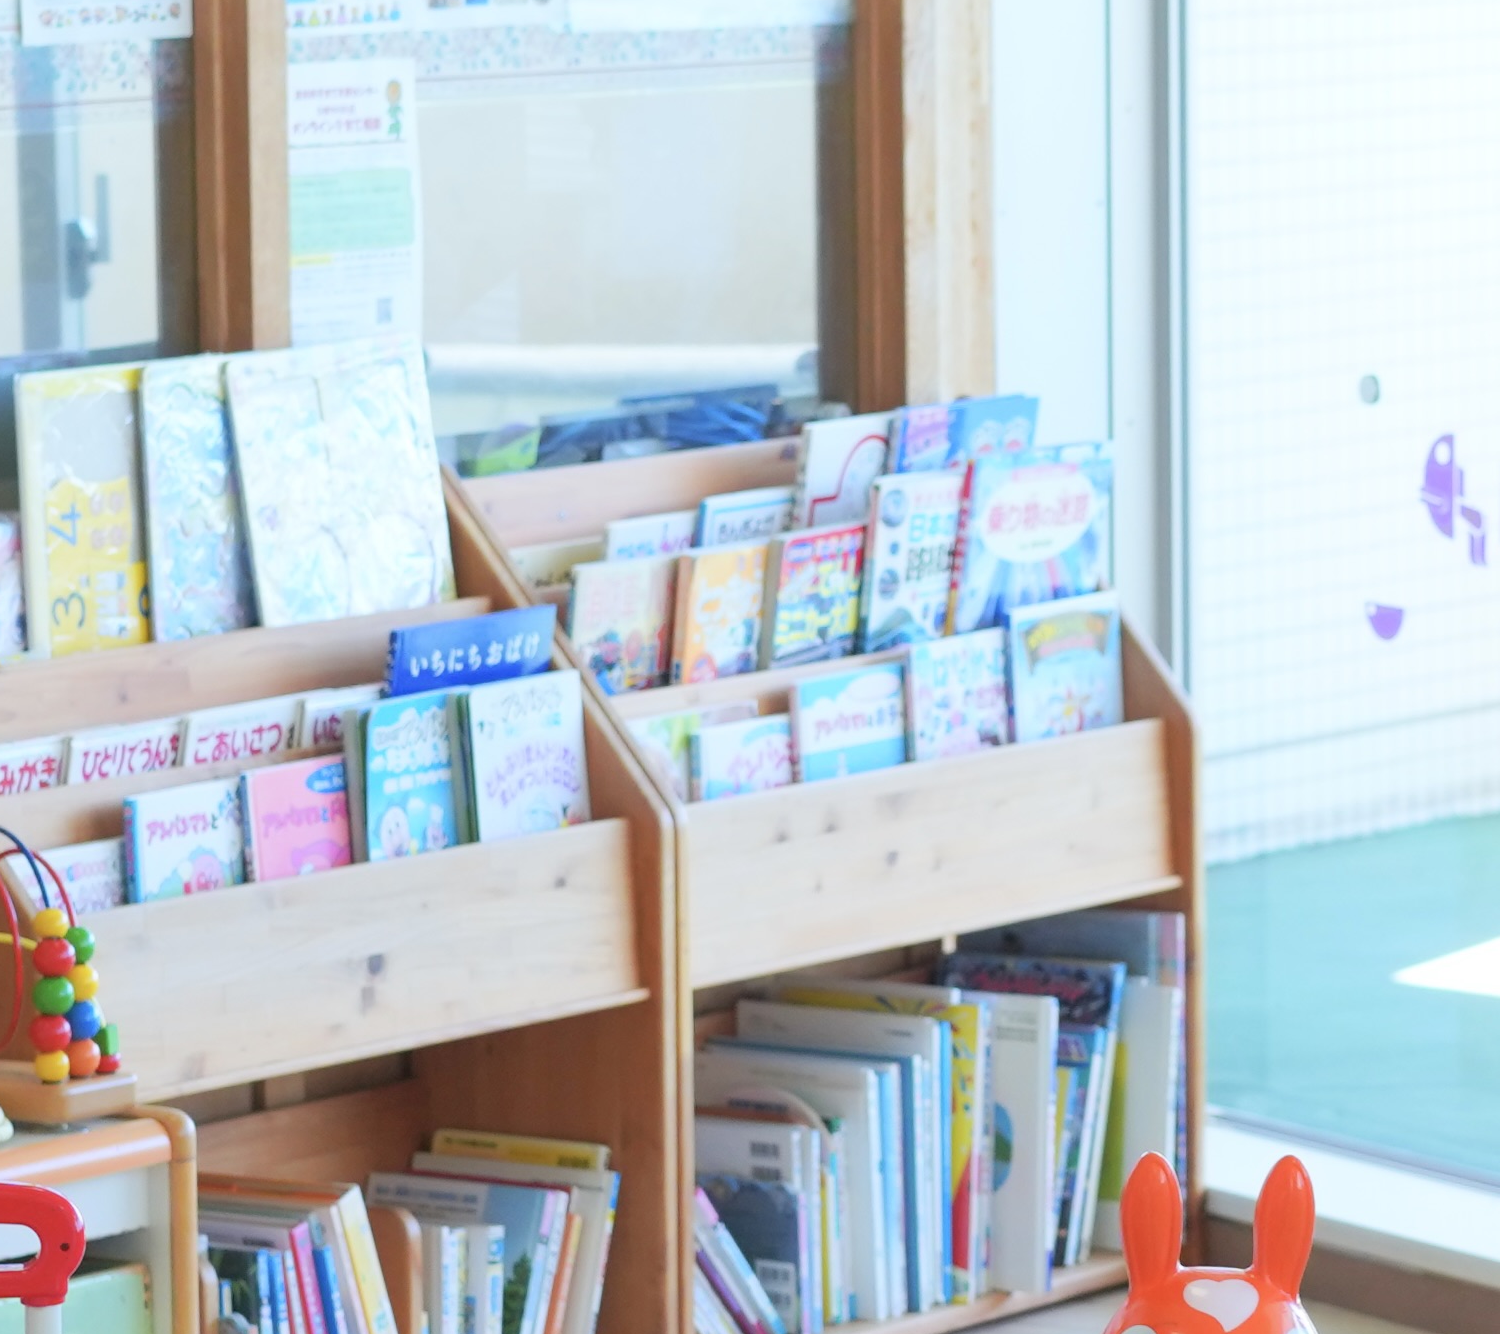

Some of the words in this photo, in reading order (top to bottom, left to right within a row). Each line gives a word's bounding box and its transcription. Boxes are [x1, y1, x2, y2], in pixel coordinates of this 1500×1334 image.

[51, 590, 88, 631] 3
[409, 632, 542, 679] いちにちおばけ
[193, 723, 284, 764] ごあいさつ
